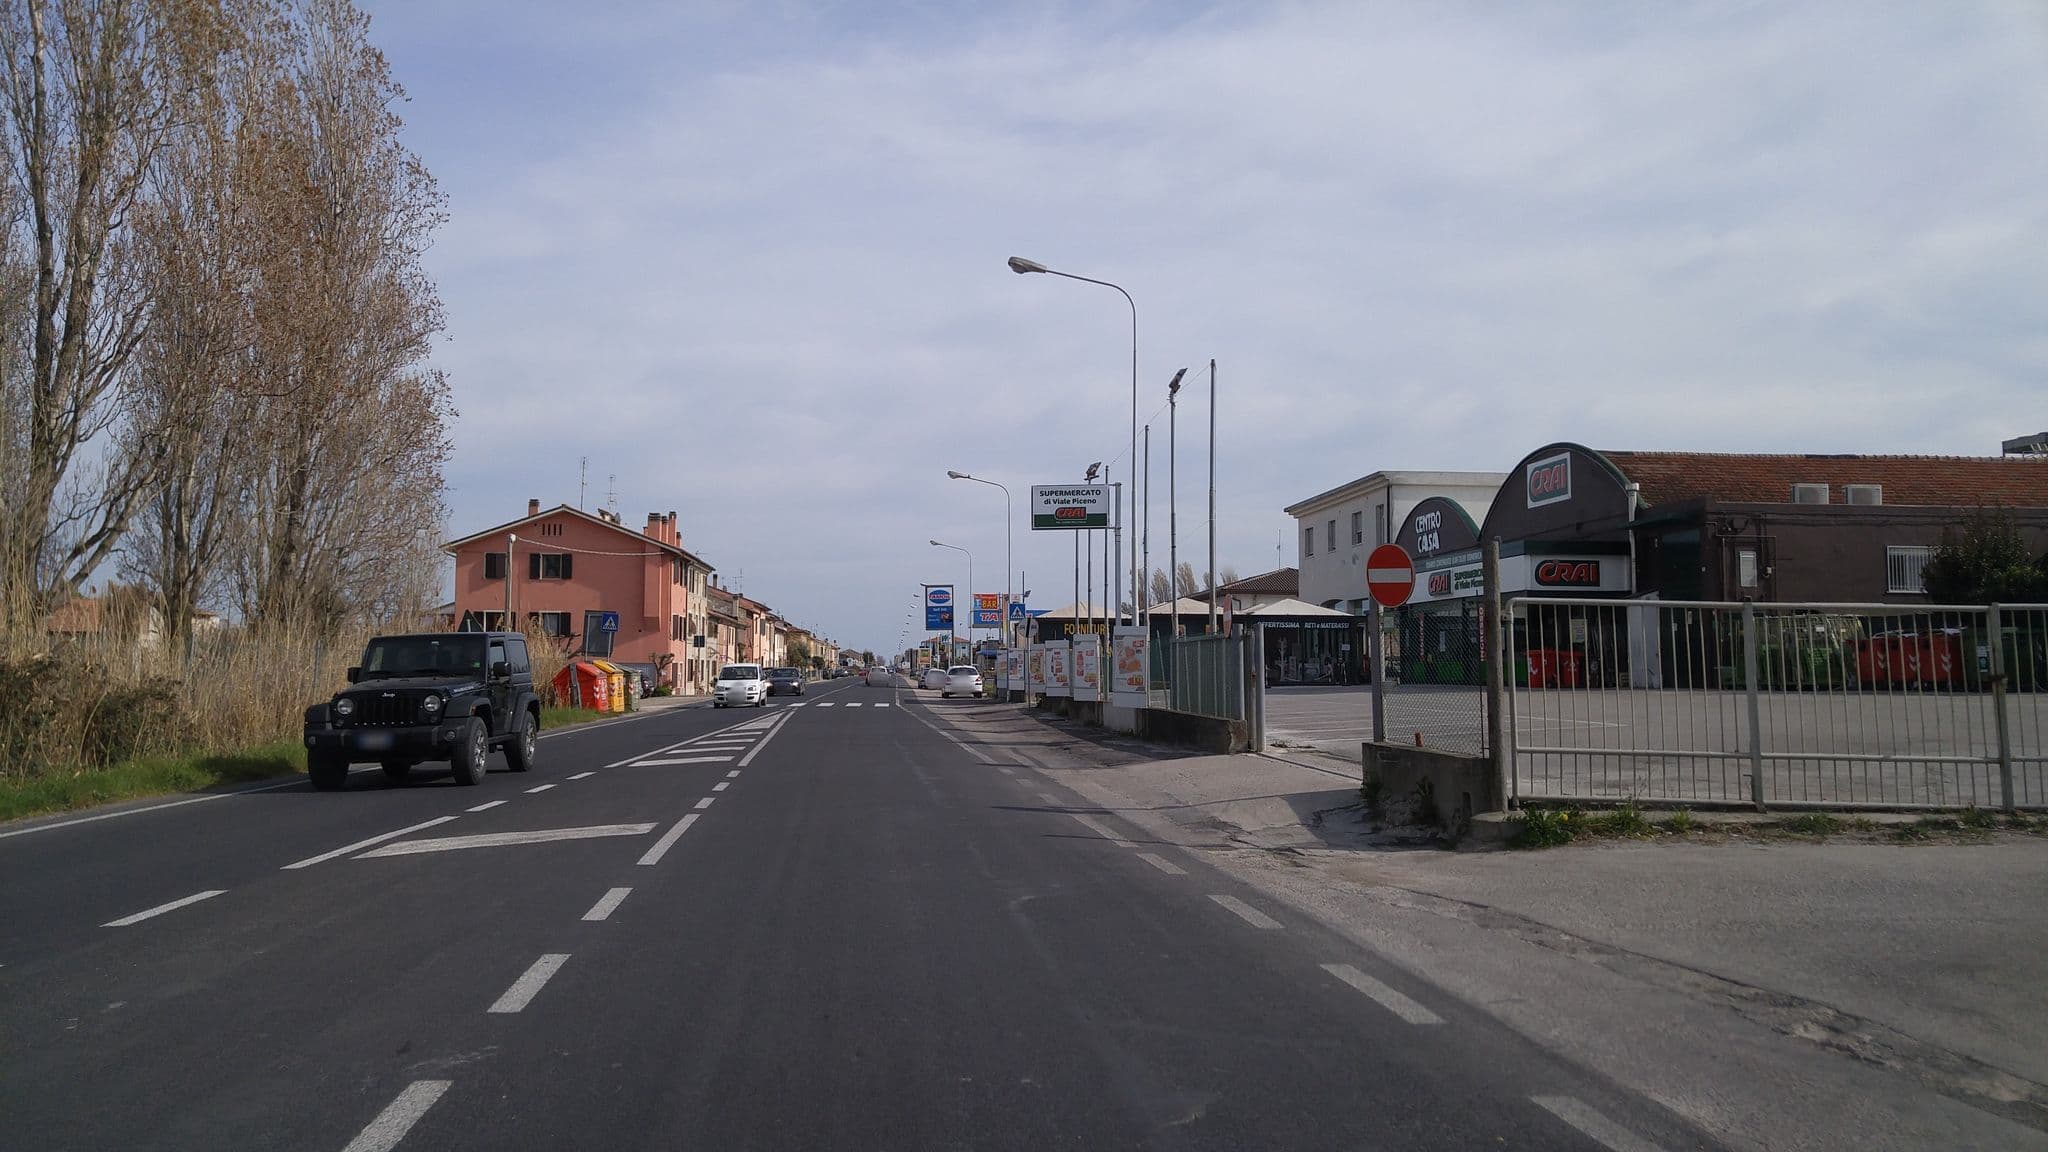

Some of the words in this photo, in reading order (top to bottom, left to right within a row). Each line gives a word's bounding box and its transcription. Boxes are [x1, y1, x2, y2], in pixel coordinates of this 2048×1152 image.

[1531, 463, 1567, 497] CRAI
[1040, 489, 1101, 497] SUPERMERCATO
[1415, 510, 1441, 534] CENTRO
[1417, 529, 1440, 553] CASA
[1538, 562, 1598, 583] CRAI
[1430, 574, 1448, 593] CRAI
[982, 600, 997, 609] BAR
